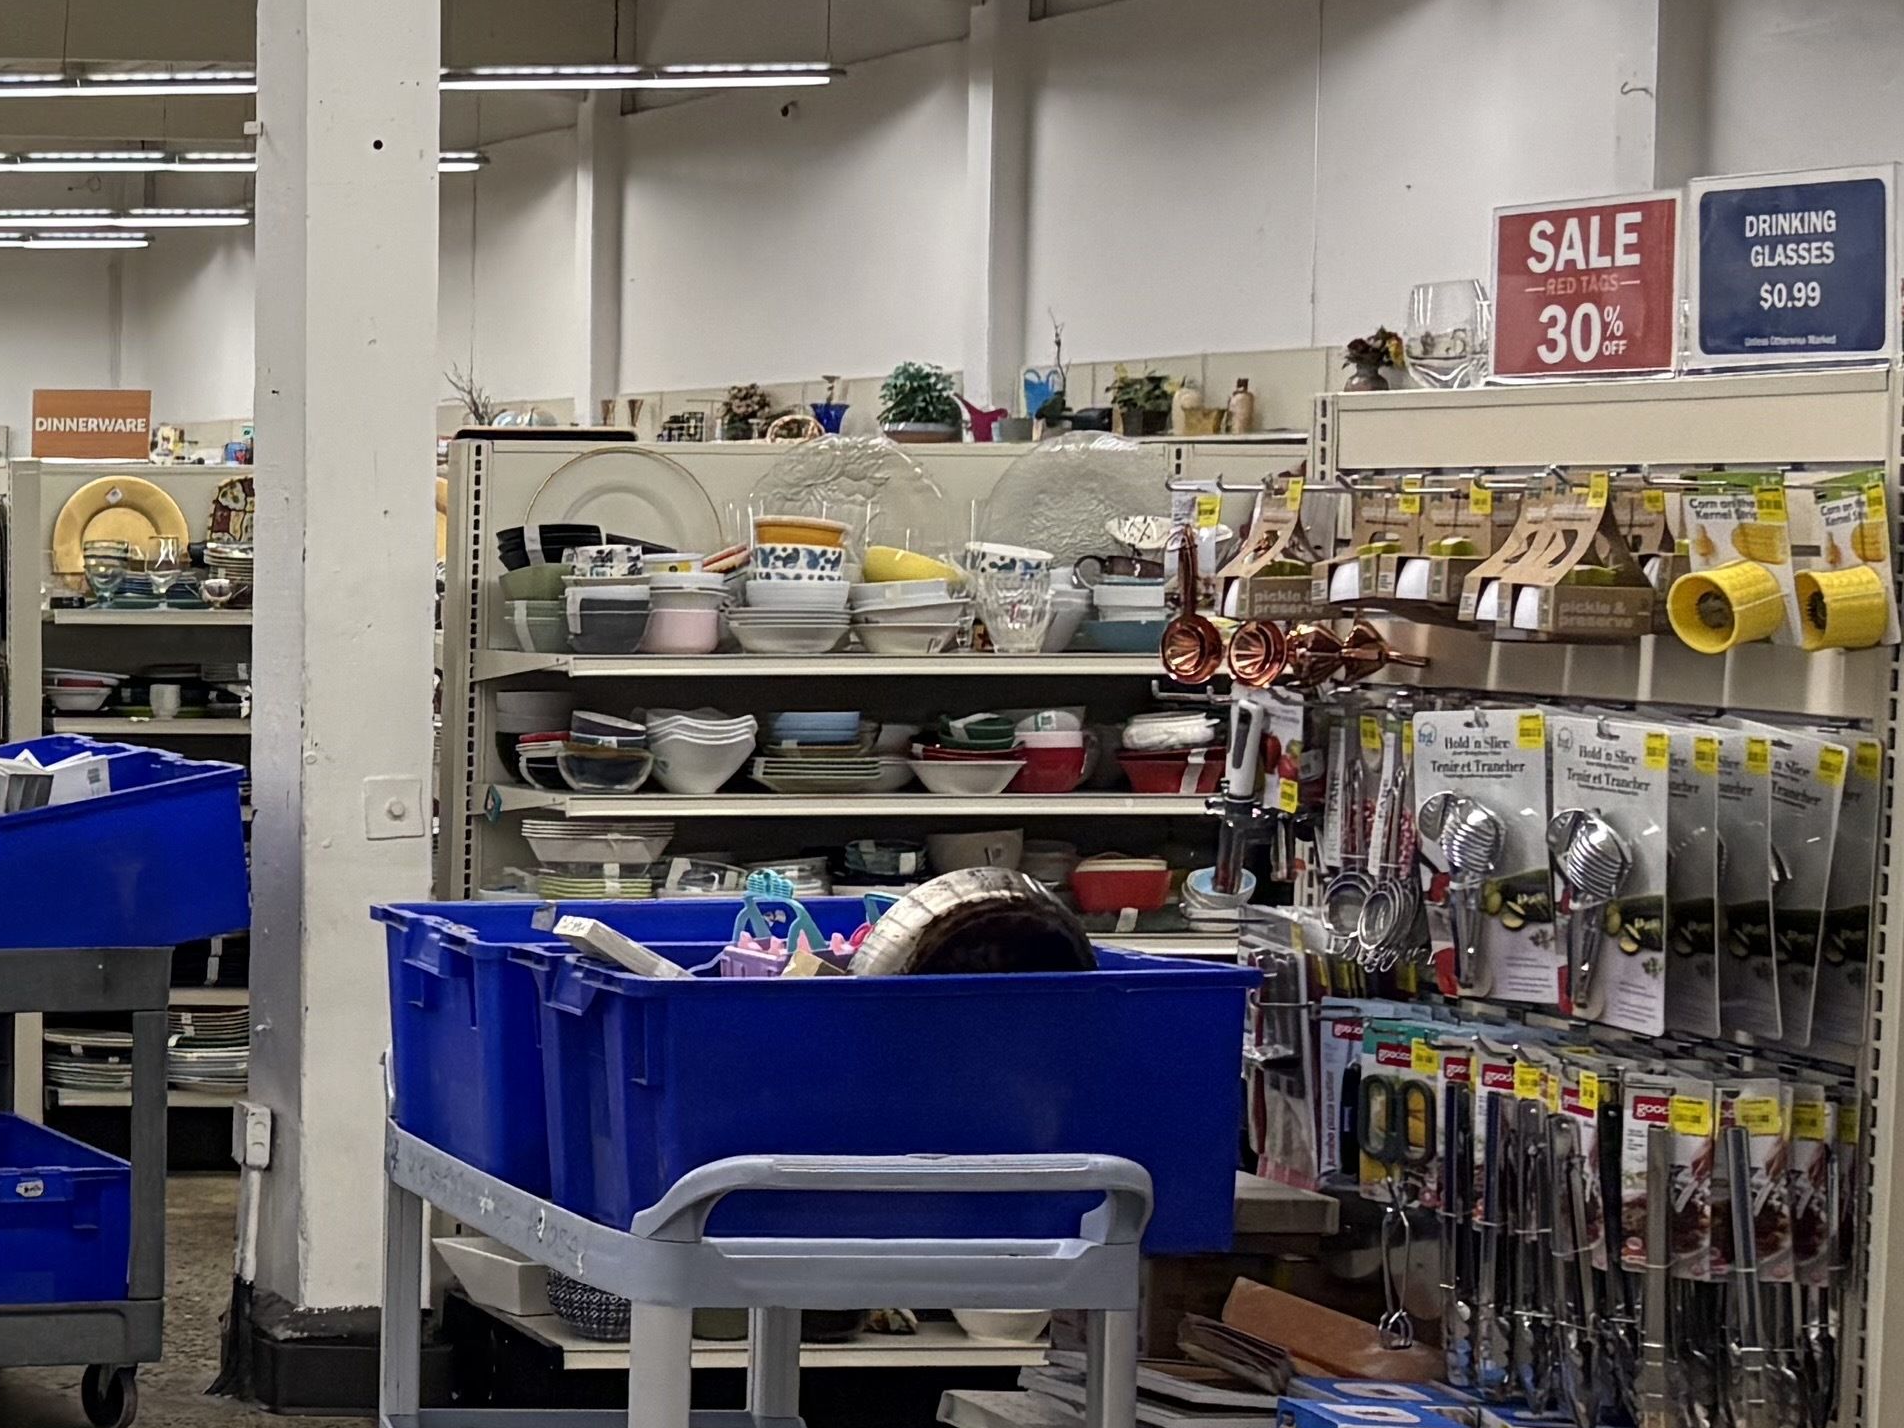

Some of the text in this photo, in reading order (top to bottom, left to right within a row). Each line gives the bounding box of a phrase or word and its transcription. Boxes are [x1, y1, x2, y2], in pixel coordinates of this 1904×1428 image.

[1745, 209, 1837, 238] DRINKING
[1527, 211, 1642, 274] SALE
[1750, 241, 1835, 268] GLASSES
[1546, 274, 1619, 296] RED TAGS
[1759, 280, 1821, 310] $0.99
[1602, 340, 1627, 356] OFF
[35, 416, 147, 433] DINNERWARE
[1689, 498, 1717, 509] Corn
[1720, 499, 1733, 509] on
[1820, 502, 1841, 516] Corn
[1695, 509, 1733, 520] Kernel
[1254, 590, 1301, 603] pickle
[1559, 600, 1611, 614] pickle
[1558, 615, 1633, 629] preserve
[1445, 736, 1470, 749] Hold
[1483, 735, 1511, 749] Slice
[1578, 744, 1602, 760] Hold
[1614, 750, 1637, 765] Slice
[1430, 759, 1526, 773] Tenir et Trancher
[1566, 766, 1592, 783] Tenir
[1604, 772, 1650, 792] Trancher
[1326, 1103, 1336, 1131] pizza
[1326, 1131, 1337, 1168] jumbo
